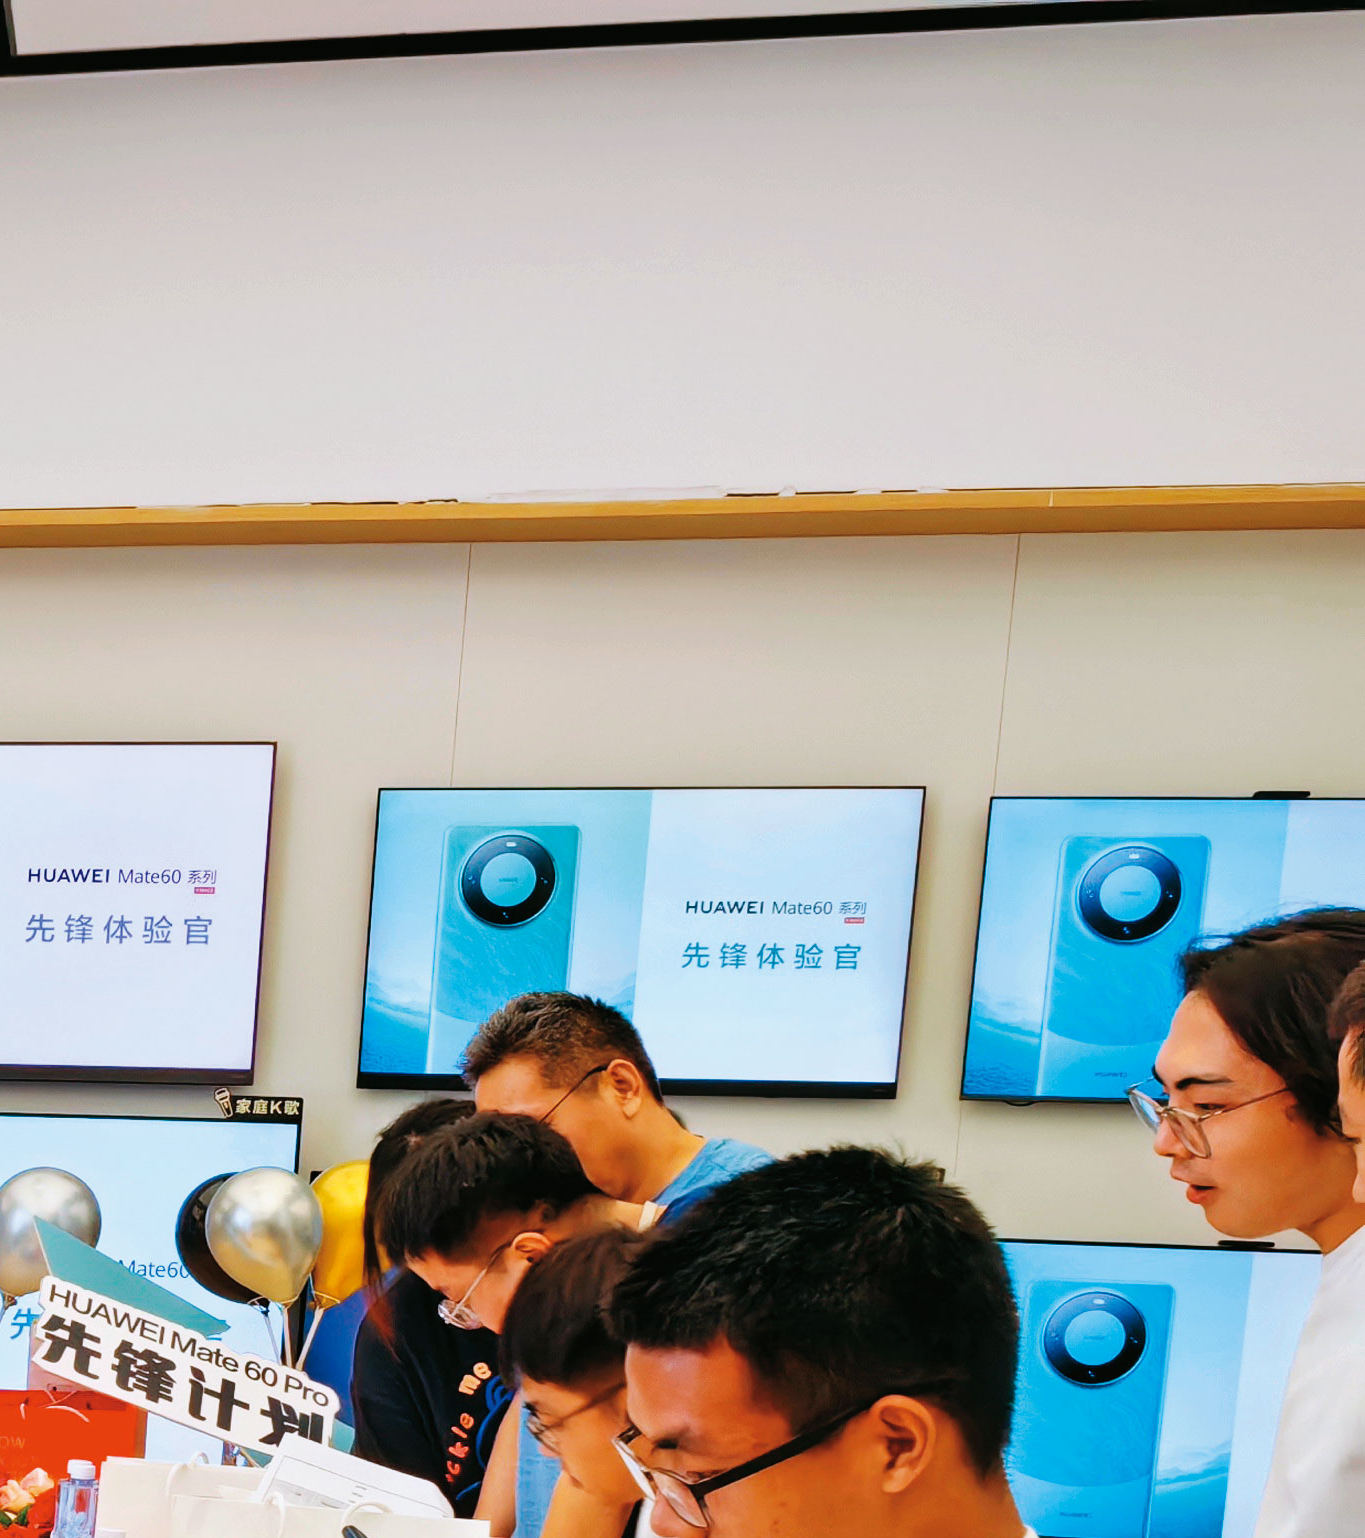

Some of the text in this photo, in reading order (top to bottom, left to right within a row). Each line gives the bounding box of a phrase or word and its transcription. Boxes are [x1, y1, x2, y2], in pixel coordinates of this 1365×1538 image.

[27, 868, 218, 885] HUAWEI Mate60 系列
[685, 900, 867, 916] HUAWEI Mate60 系列
[25, 913, 214, 946] 先锋体验官
[681, 941, 863, 971] 先锋体验官
[235, 1097, 300, 1117] 家庭K歌
[49, 1283, 166, 1346] HUAWEI
[170, 1330, 239, 1374] Mate
[243, 1359, 278, 1388] 60
[284, 1371, 330, 1408] Pro
[40, 1313, 325, 1448] 先锋计划
[458, 1361, 492, 1396] me
